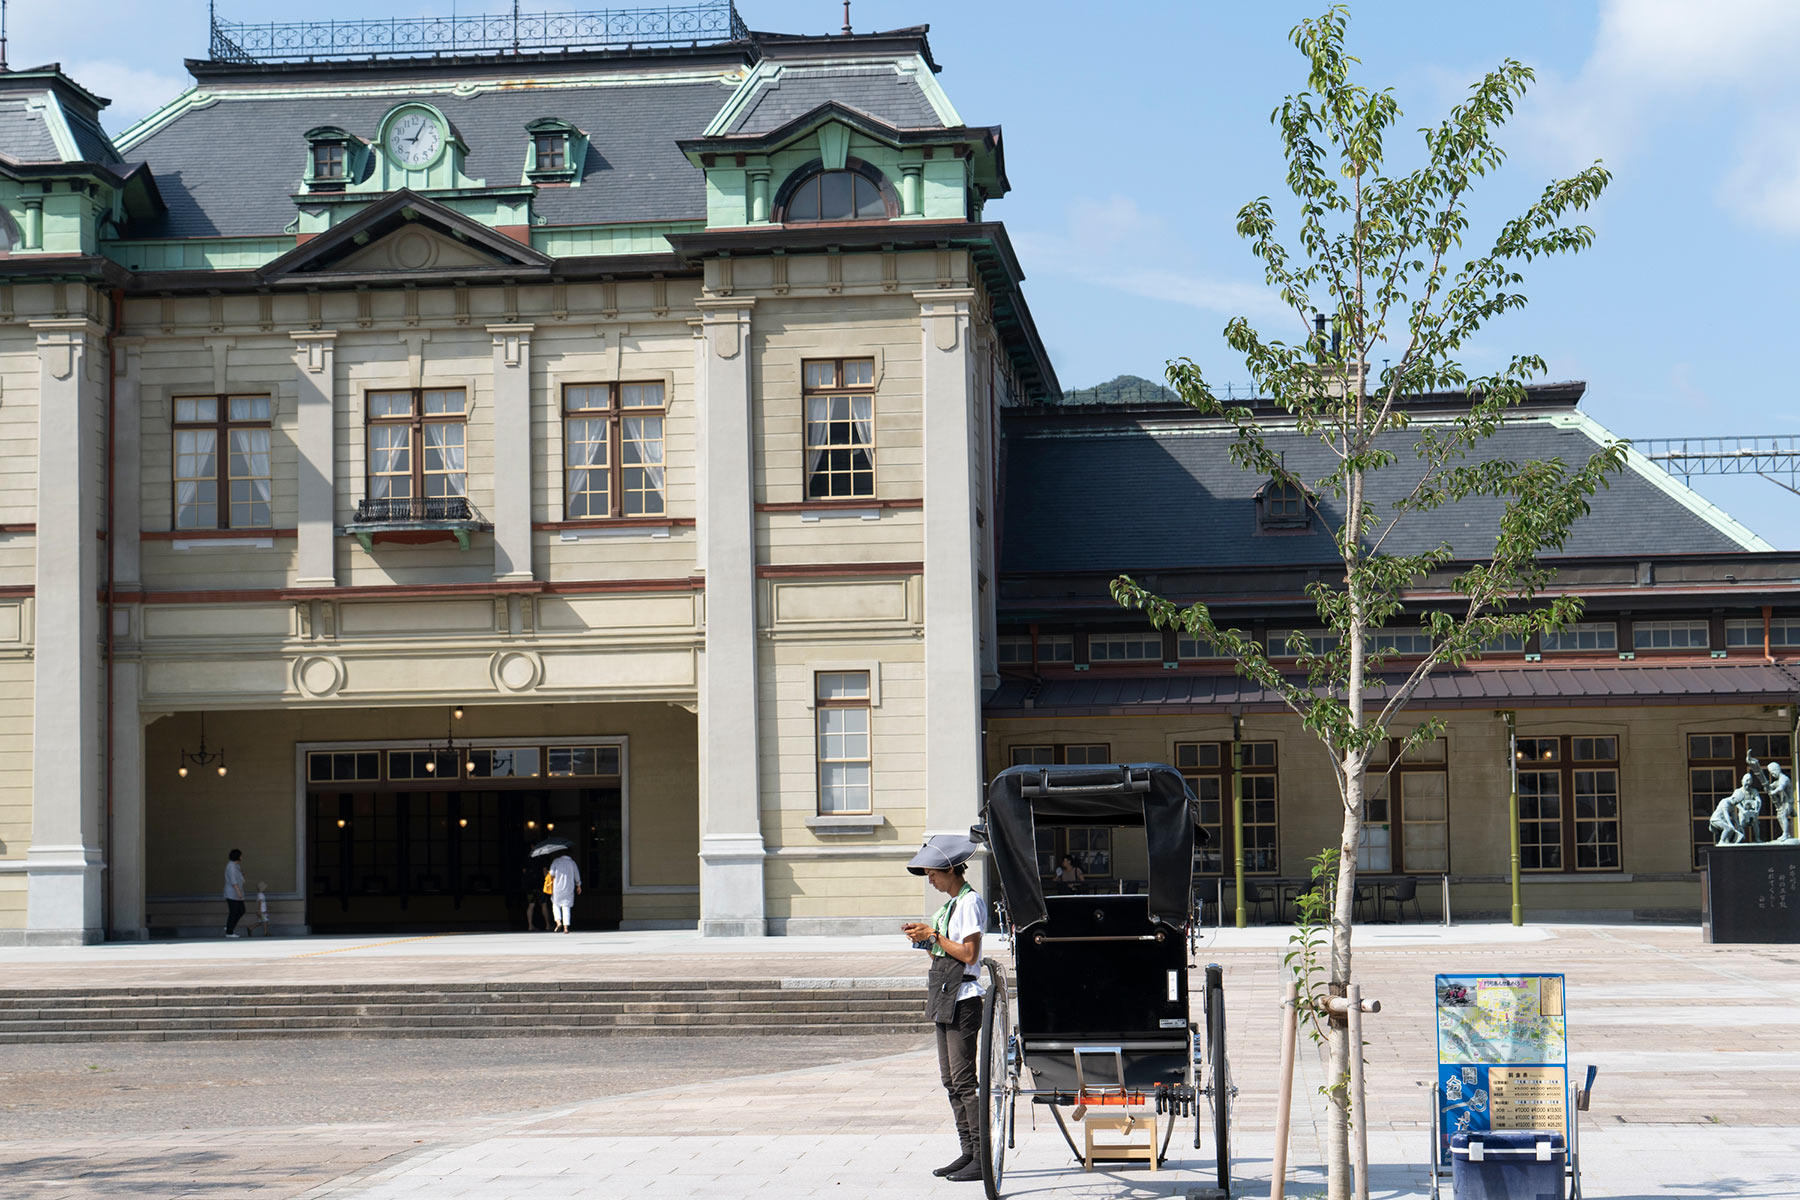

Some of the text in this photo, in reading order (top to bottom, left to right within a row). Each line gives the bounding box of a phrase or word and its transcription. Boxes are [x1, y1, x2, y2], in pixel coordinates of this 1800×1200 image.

[412, 117, 419, 126] 12
[428, 126, 434, 134] 2
[432, 135, 437, 144] 3
[398, 145, 403, 154] 8
[405, 152, 410, 160] 7
[413, 153, 419, 161] 6
[422, 151, 429, 160] 5
